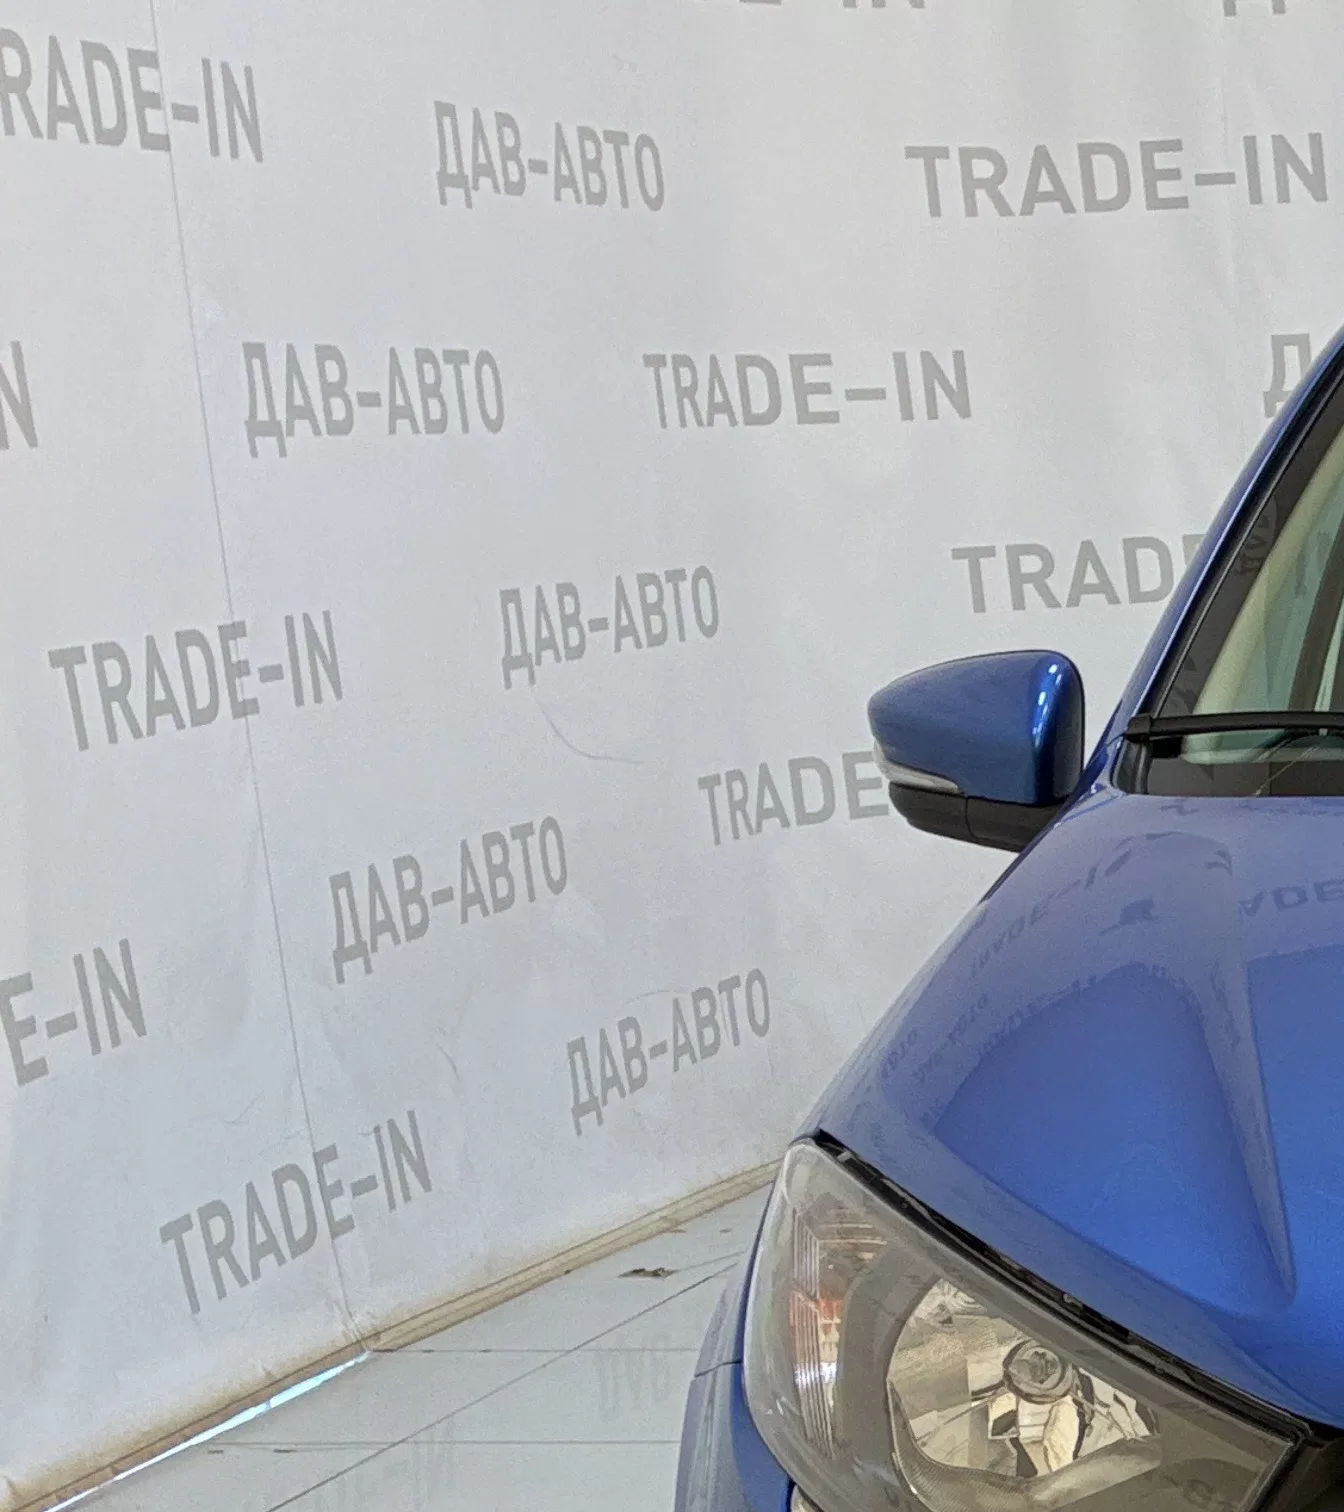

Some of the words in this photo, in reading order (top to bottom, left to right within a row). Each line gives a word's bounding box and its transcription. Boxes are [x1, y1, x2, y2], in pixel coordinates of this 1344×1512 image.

[433, 100, 665, 211] ДАВ-АВТО
[904, 133, 1329, 218] TRADE-IN
[243, 342, 503, 458] ДАВ-АВТО
[643, 350, 971, 429] TRADE-IN
[49, 610, 344, 751] TRADE-IN
[499, 566, 719, 689] ДАВ-АВТО
[329, 816, 568, 983] ДАВ-АВТО
[566, 967, 771, 1136] ДАВ-АВТО
[160, 1110, 433, 1315] TRADE-IN
